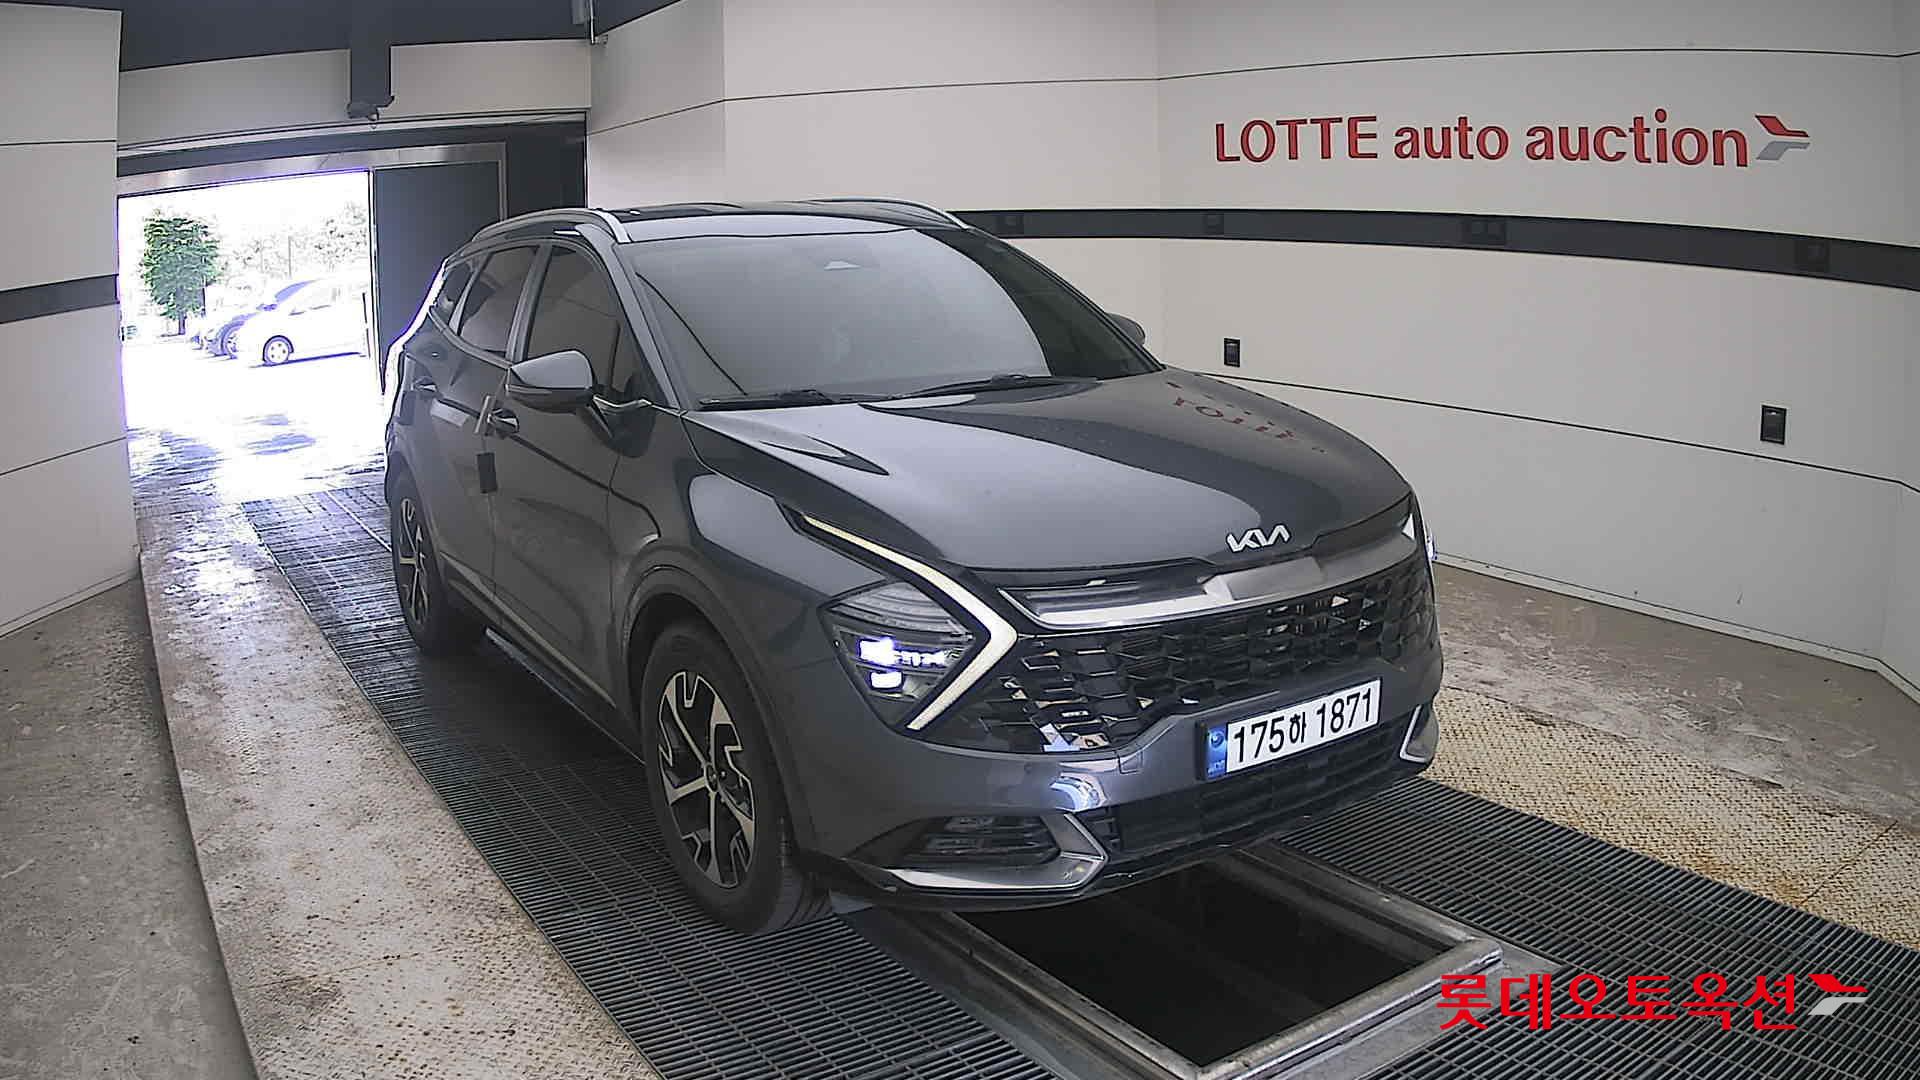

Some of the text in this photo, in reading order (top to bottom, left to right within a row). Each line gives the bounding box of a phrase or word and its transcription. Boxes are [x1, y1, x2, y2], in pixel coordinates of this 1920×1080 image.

[1215, 108, 1749, 167] LOTTE auto auction
[1226, 524, 1291, 552] KIA
[1233, 688, 1372, 763] 175하 1871
